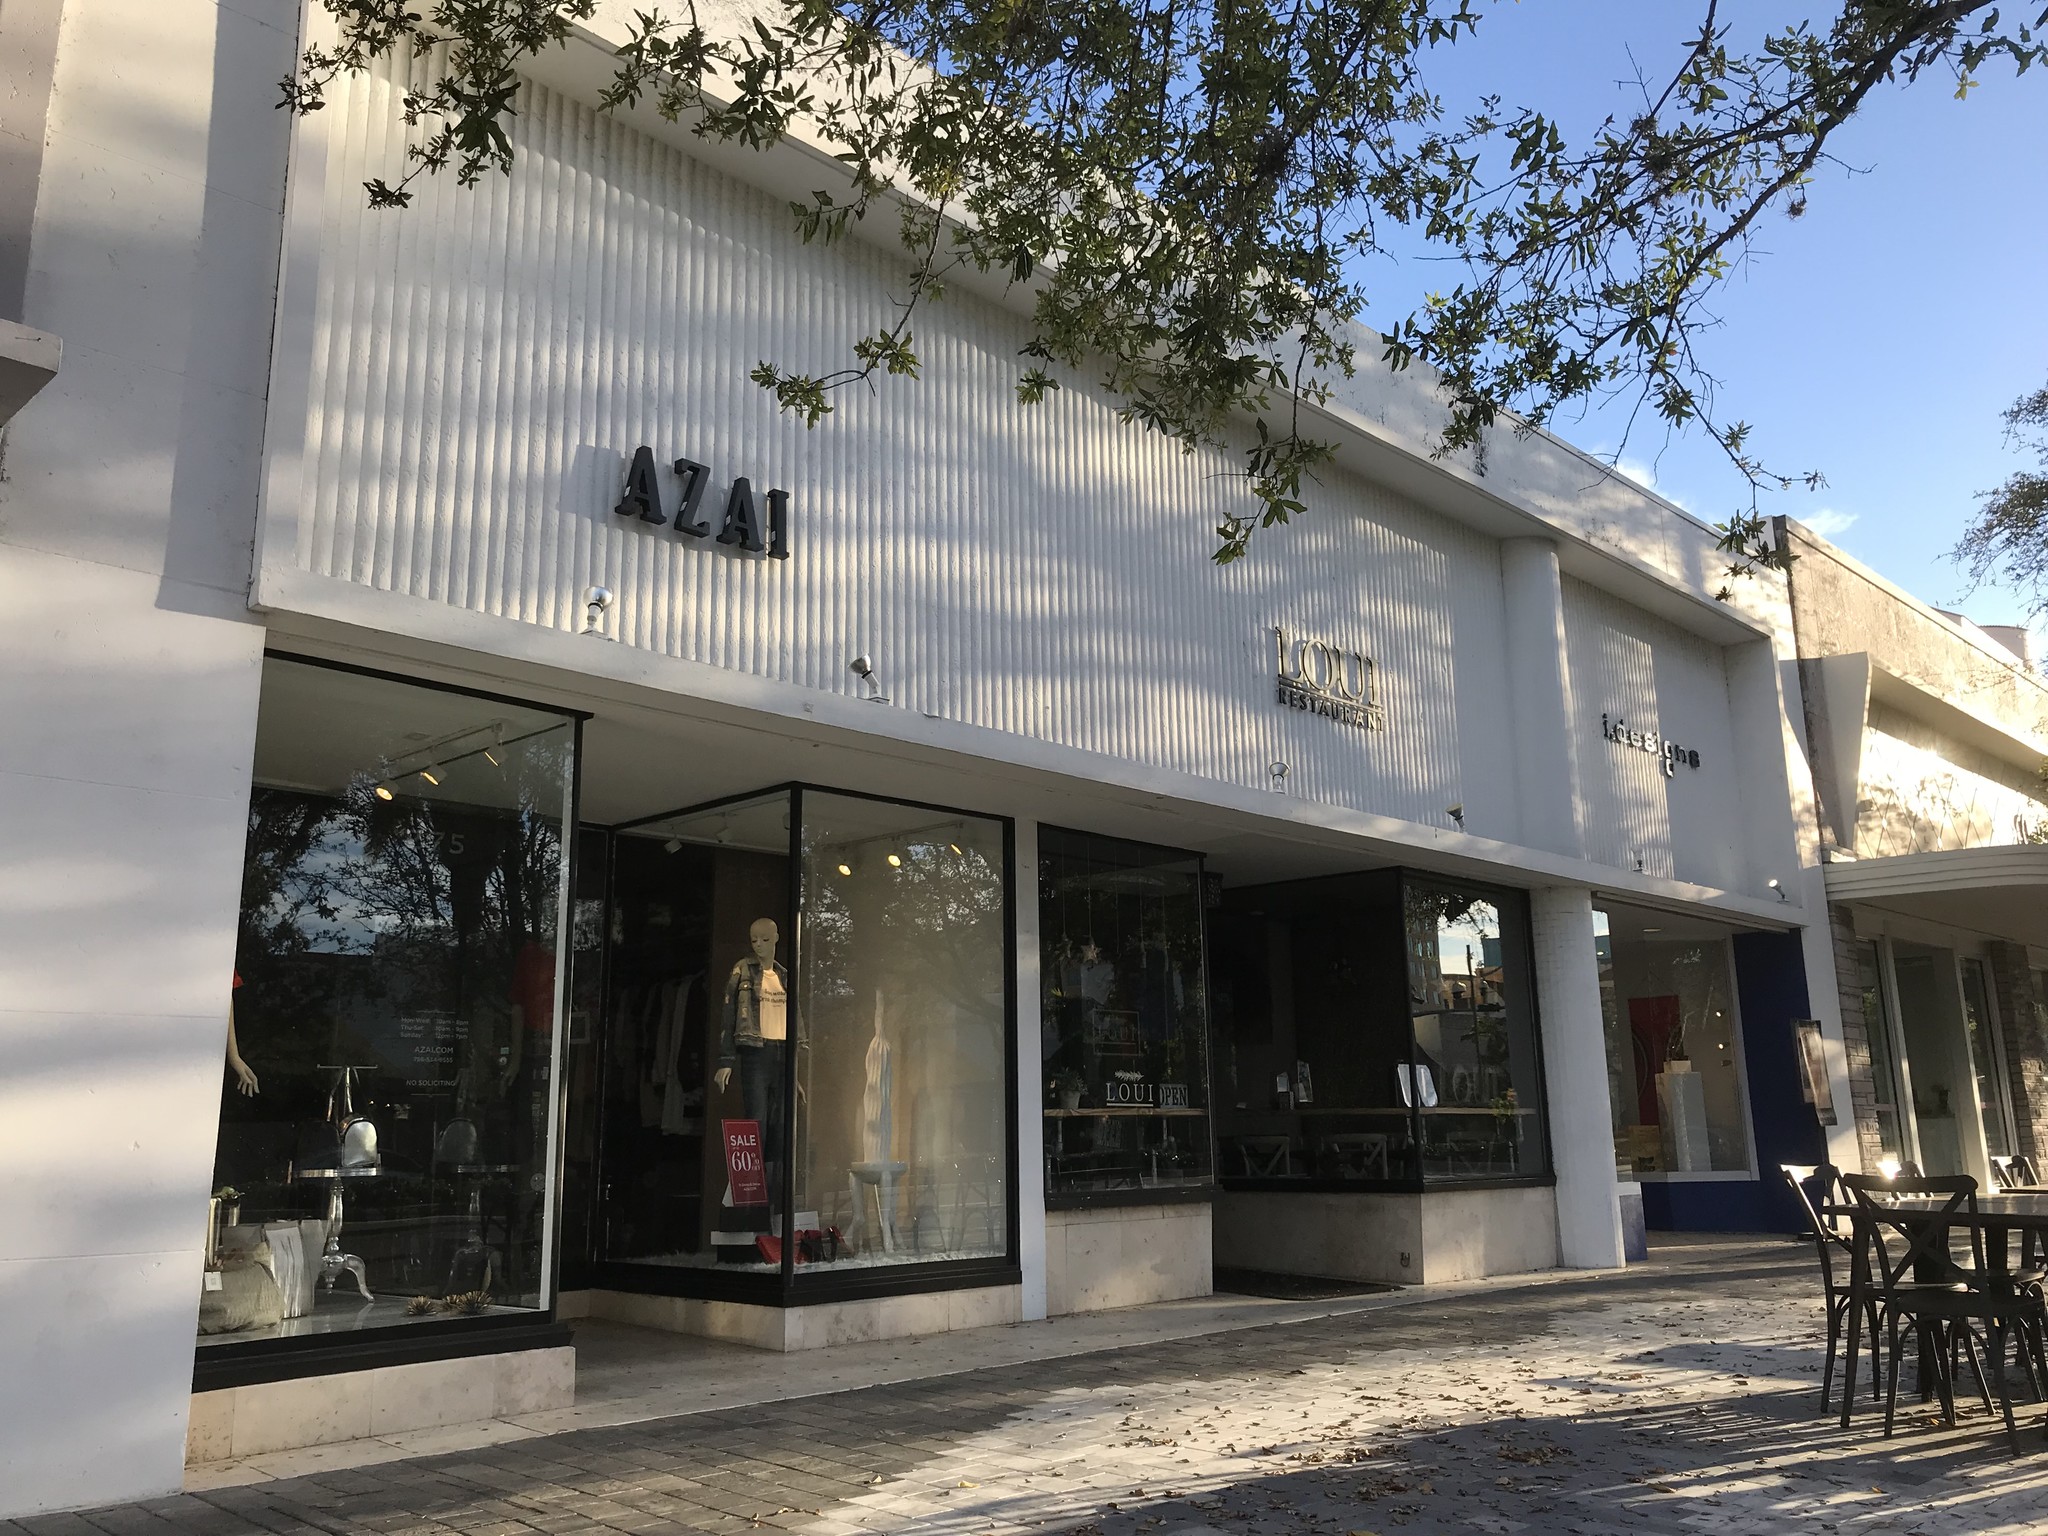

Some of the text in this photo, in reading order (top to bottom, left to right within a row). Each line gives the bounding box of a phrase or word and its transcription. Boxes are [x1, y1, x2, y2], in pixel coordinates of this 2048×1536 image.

[614, 445, 790, 560] AZAI
[1275, 626, 1383, 707] LOUI
[1278, 688, 1387, 732] RESTAURANT
[418, 1079, 456, 1087] SOLICITING
[1105, 1082, 1154, 1102] LOUI
[730, 1134, 757, 1146] SALE
